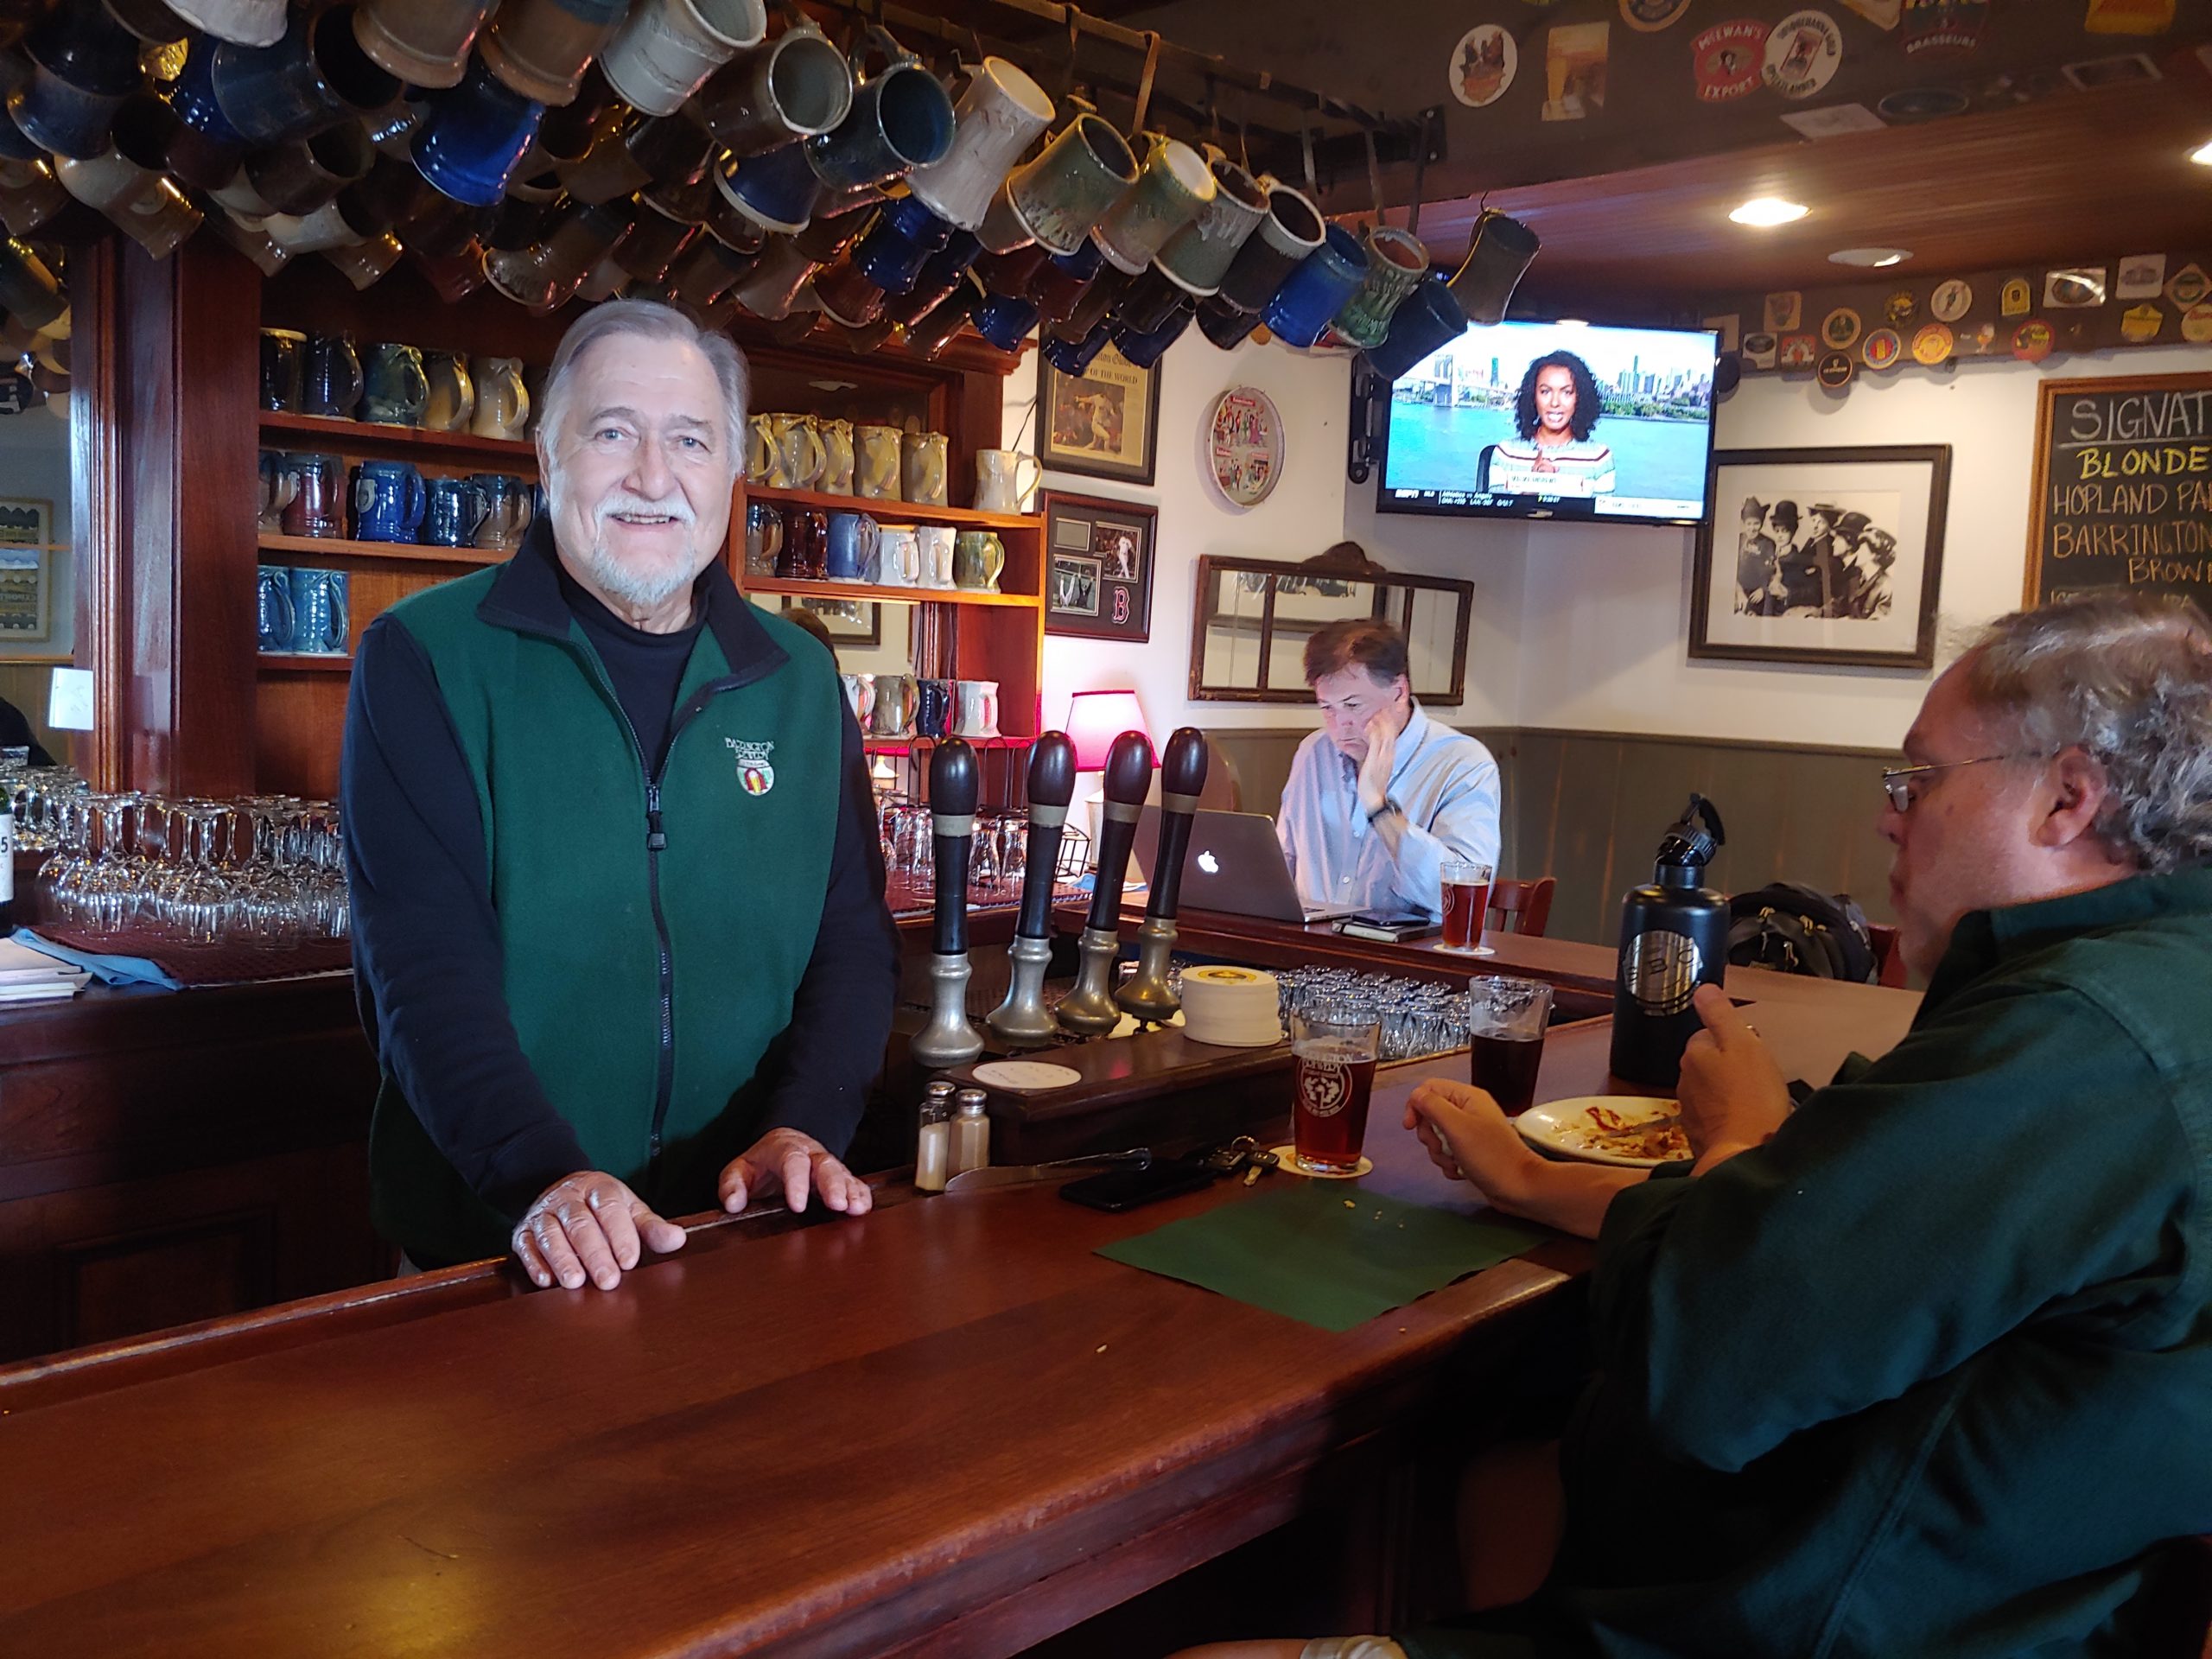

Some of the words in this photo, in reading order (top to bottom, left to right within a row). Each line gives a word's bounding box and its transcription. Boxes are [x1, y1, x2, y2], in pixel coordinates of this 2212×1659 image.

[1704, 76, 1753, 99] EXPORT
[1114, 372, 1139, 385] WORLD
[2075, 445, 2212, 480] BLONDE
[2053, 483, 2169, 517] HOPLAND
[2052, 520, 2212, 559] BARRINGTON
[1113, 588, 1128, 623] B
